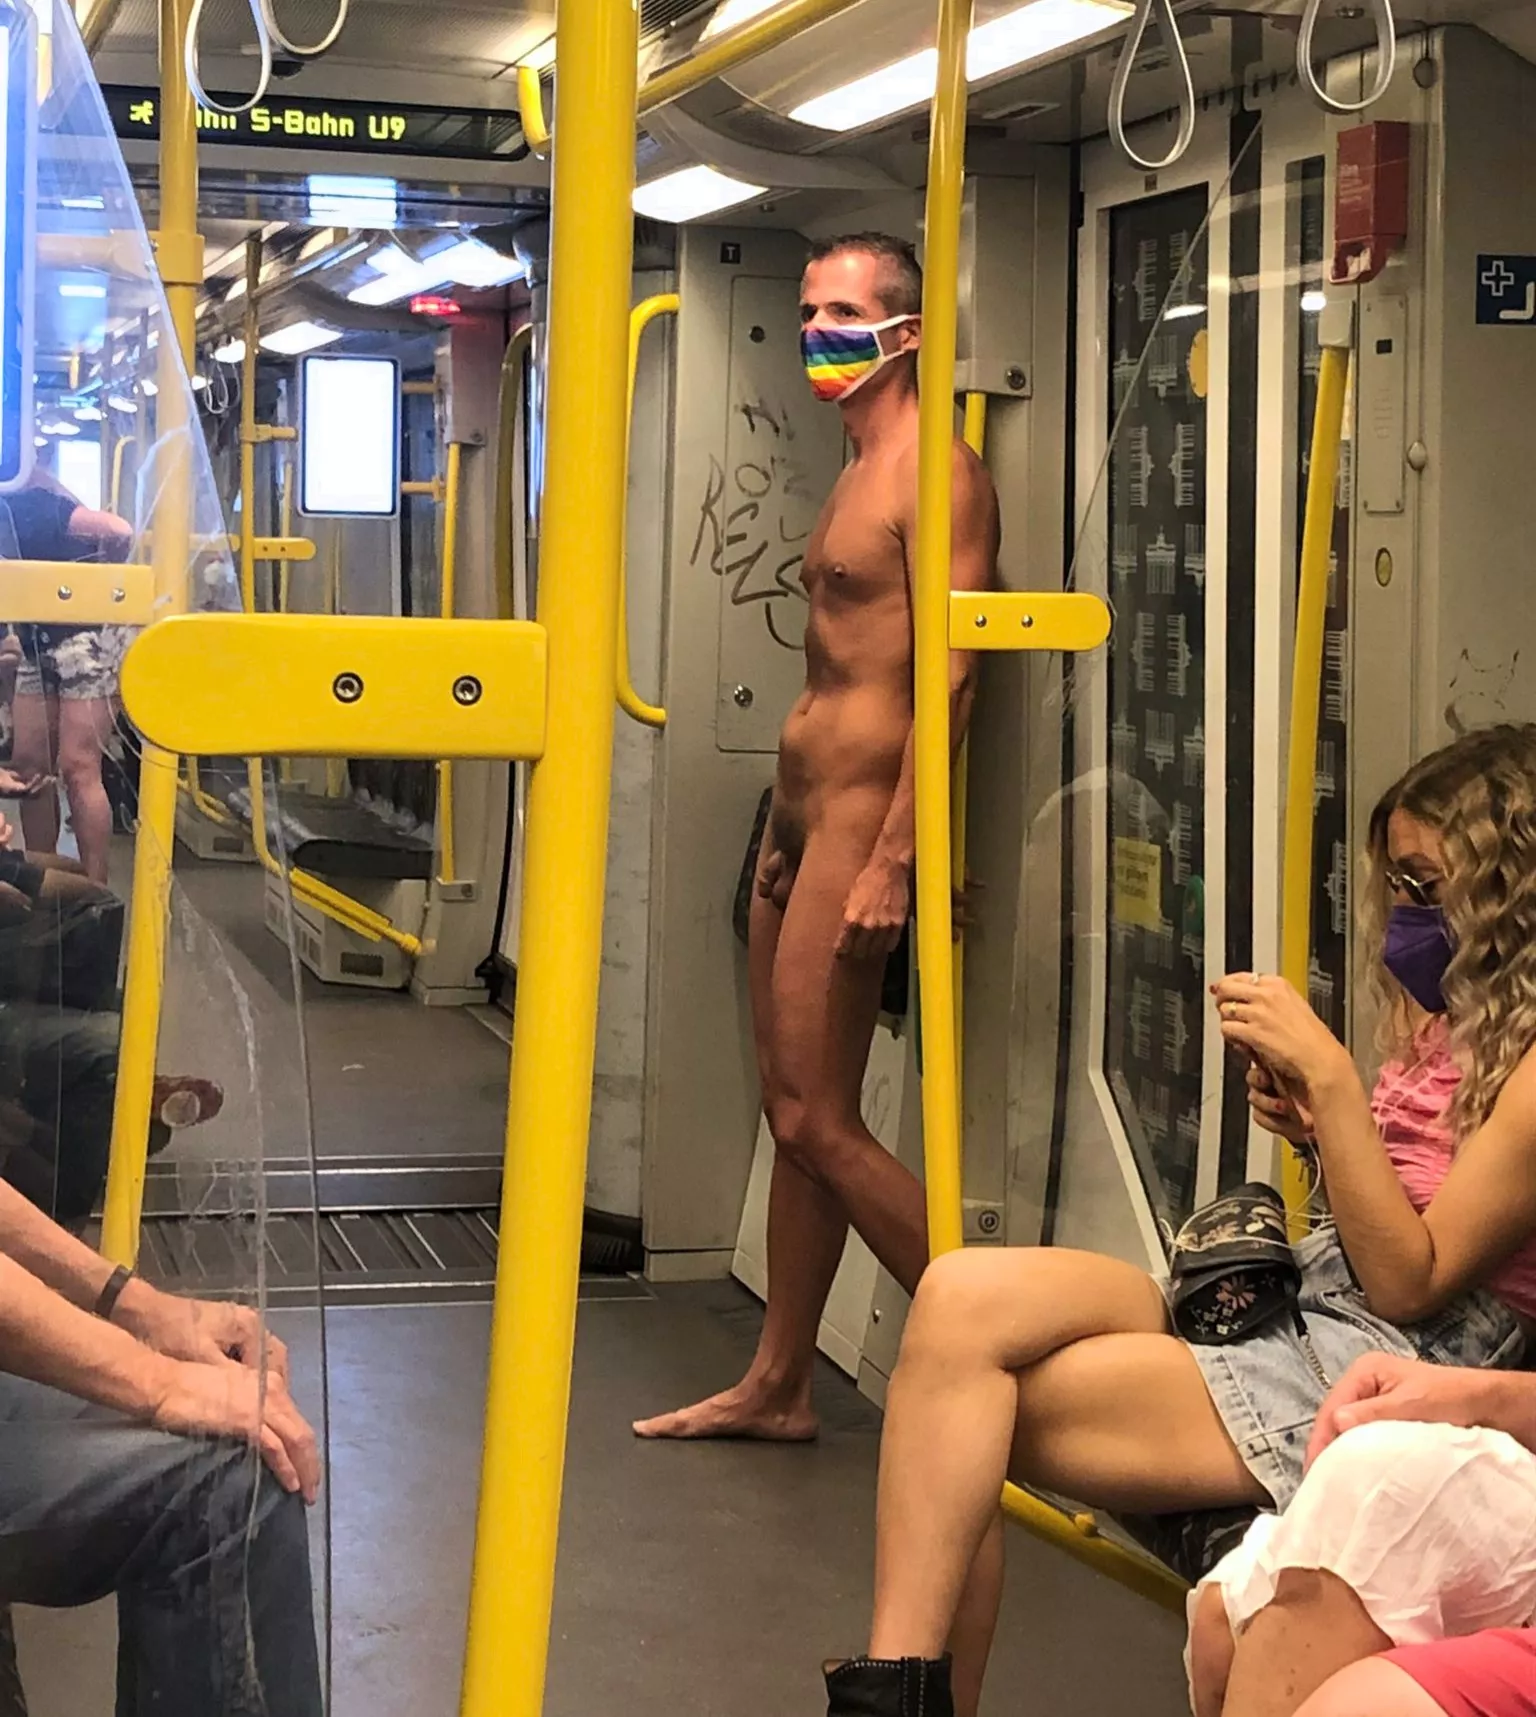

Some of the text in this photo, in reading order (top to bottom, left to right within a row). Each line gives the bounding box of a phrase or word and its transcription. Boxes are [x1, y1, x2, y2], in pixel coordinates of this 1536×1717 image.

[251, 107, 354, 137] S-Bahn
[368, 115, 406, 140] U9
[726, 245, 737, 261] T
